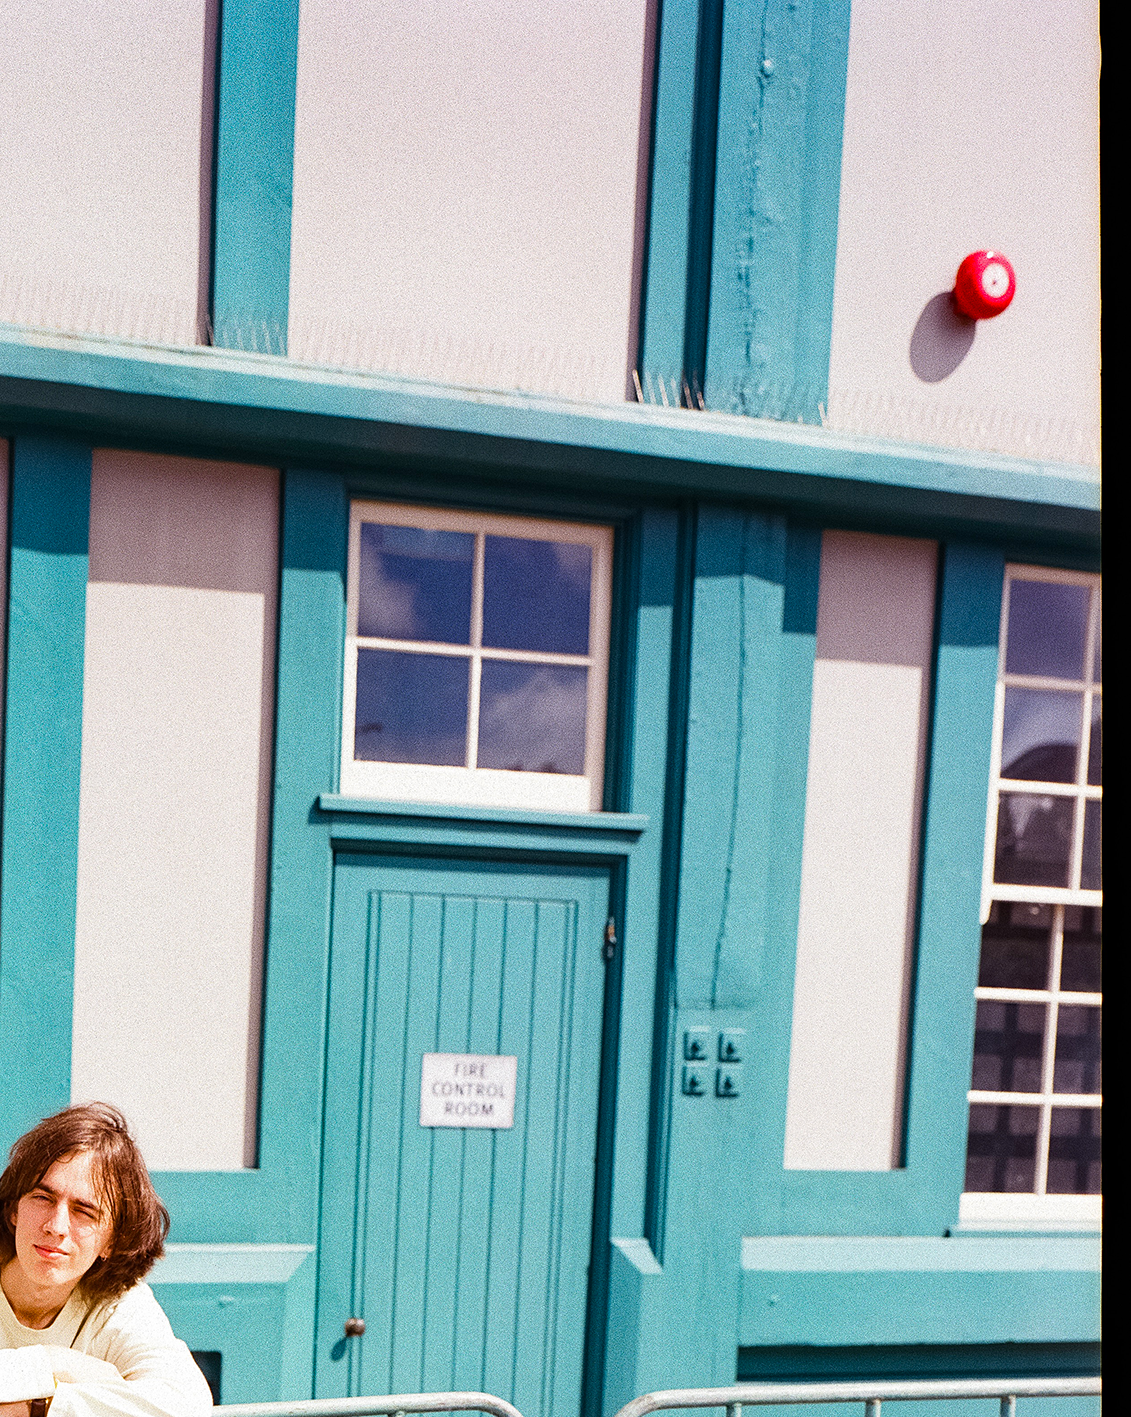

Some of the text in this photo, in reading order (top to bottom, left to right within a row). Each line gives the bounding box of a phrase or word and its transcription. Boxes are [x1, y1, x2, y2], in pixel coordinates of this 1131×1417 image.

[454, 1062, 488, 1079] FIRE
[432, 1081, 505, 1099] CONTROL
[444, 1101, 494, 1116] ROOM
